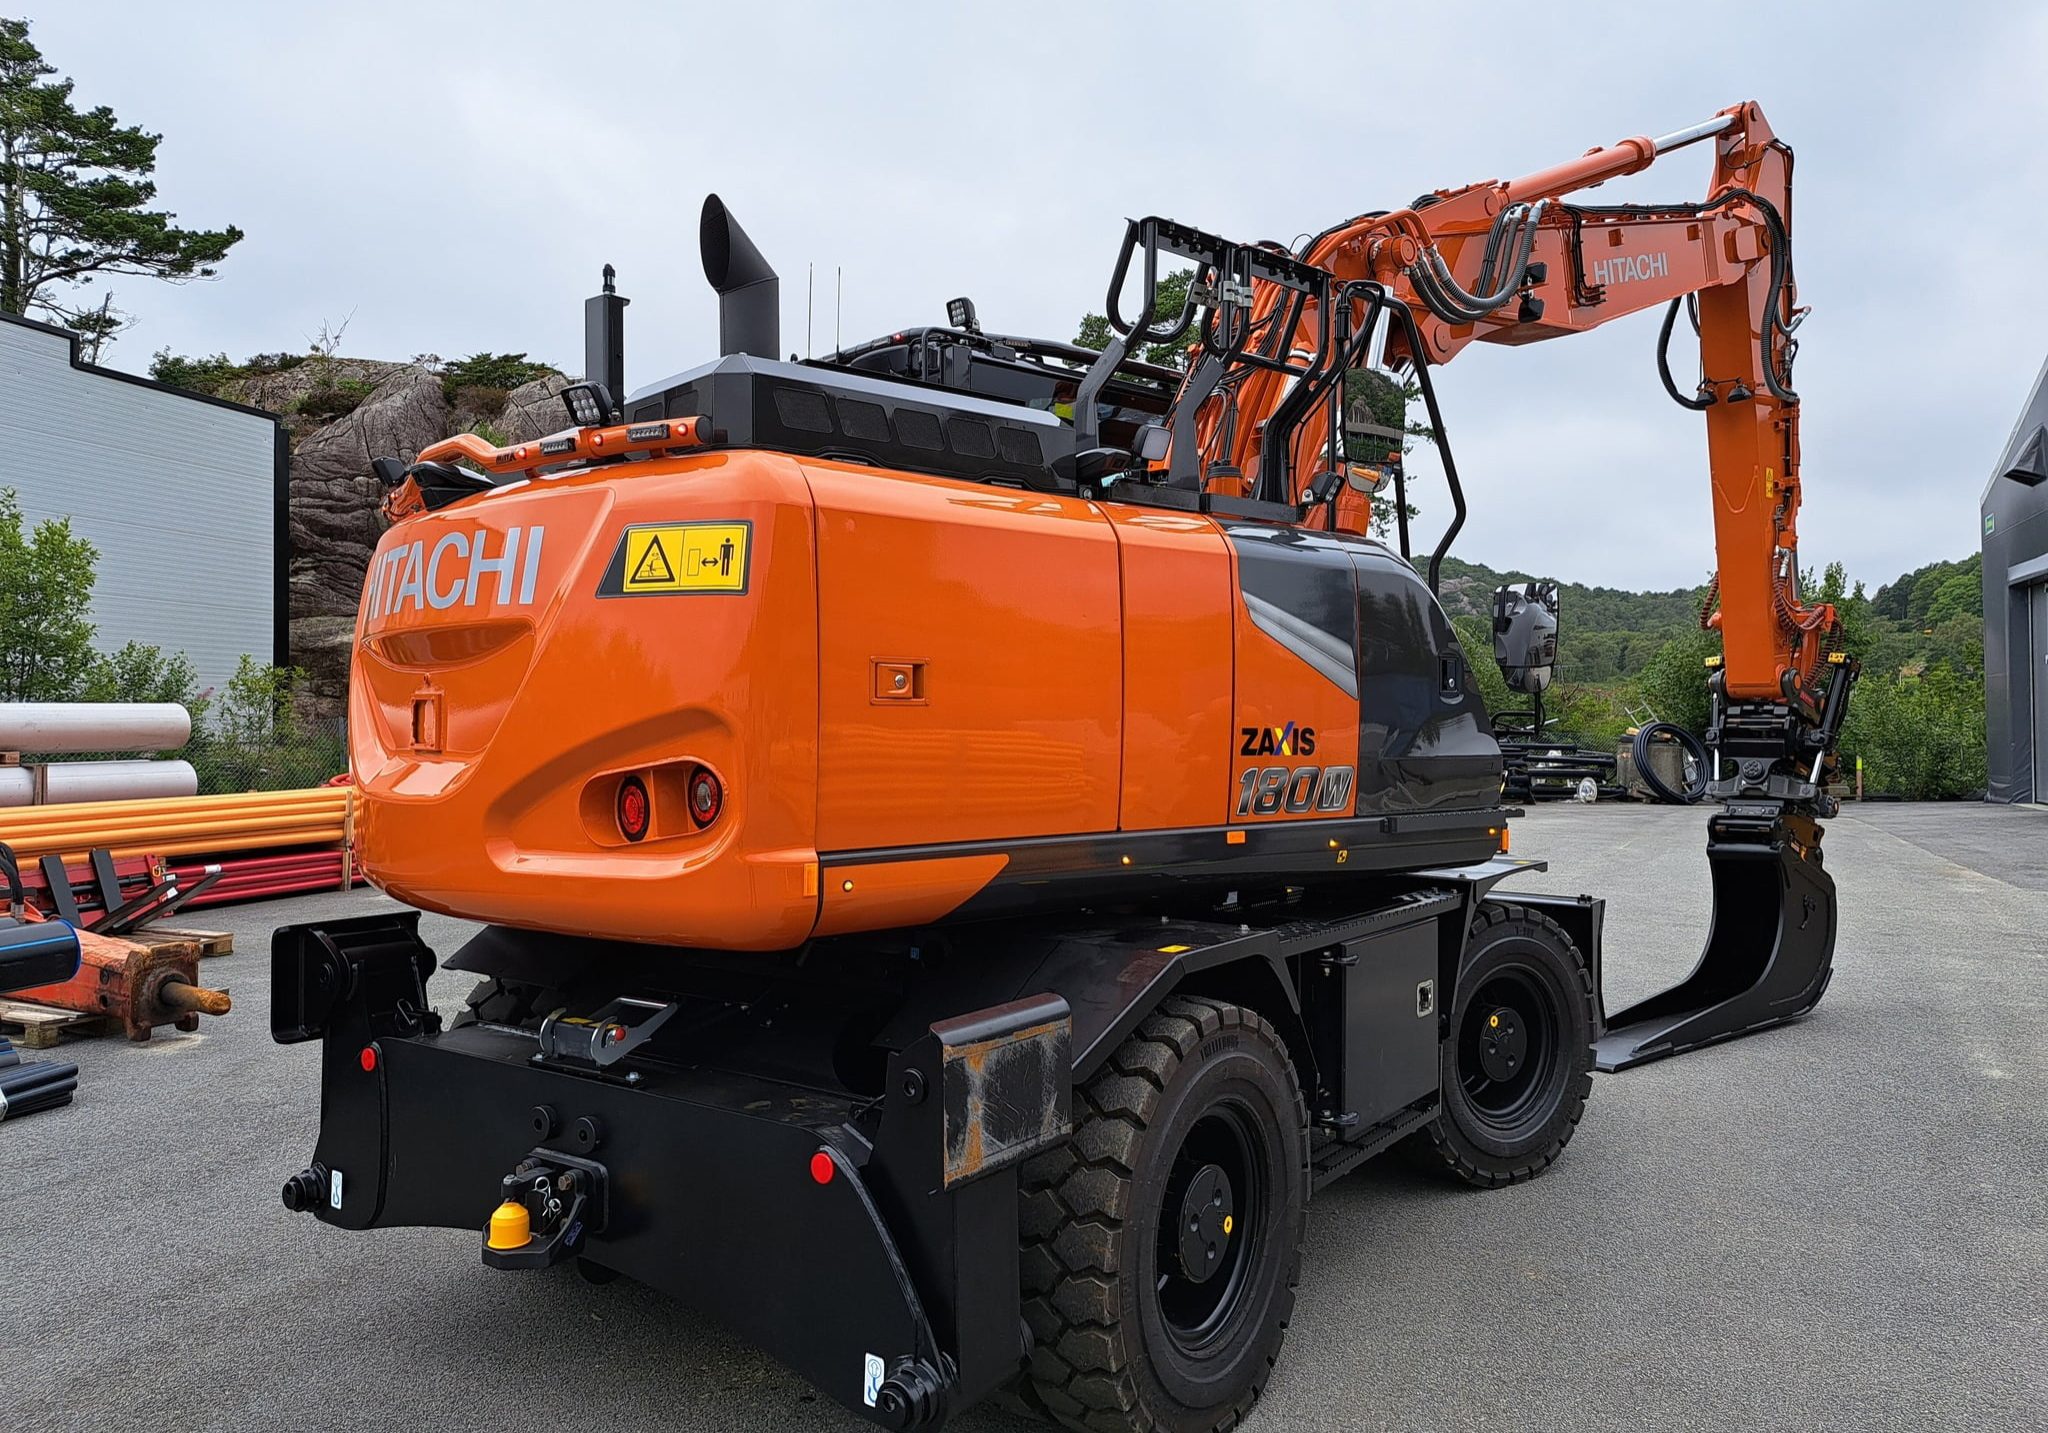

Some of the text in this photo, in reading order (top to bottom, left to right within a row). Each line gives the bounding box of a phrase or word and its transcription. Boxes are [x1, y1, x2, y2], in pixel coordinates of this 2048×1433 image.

[1594, 252, 1668, 285] HITACHI
[1240, 721, 1316, 757] ZAXIS
[1236, 765, 1355, 817] 180W
